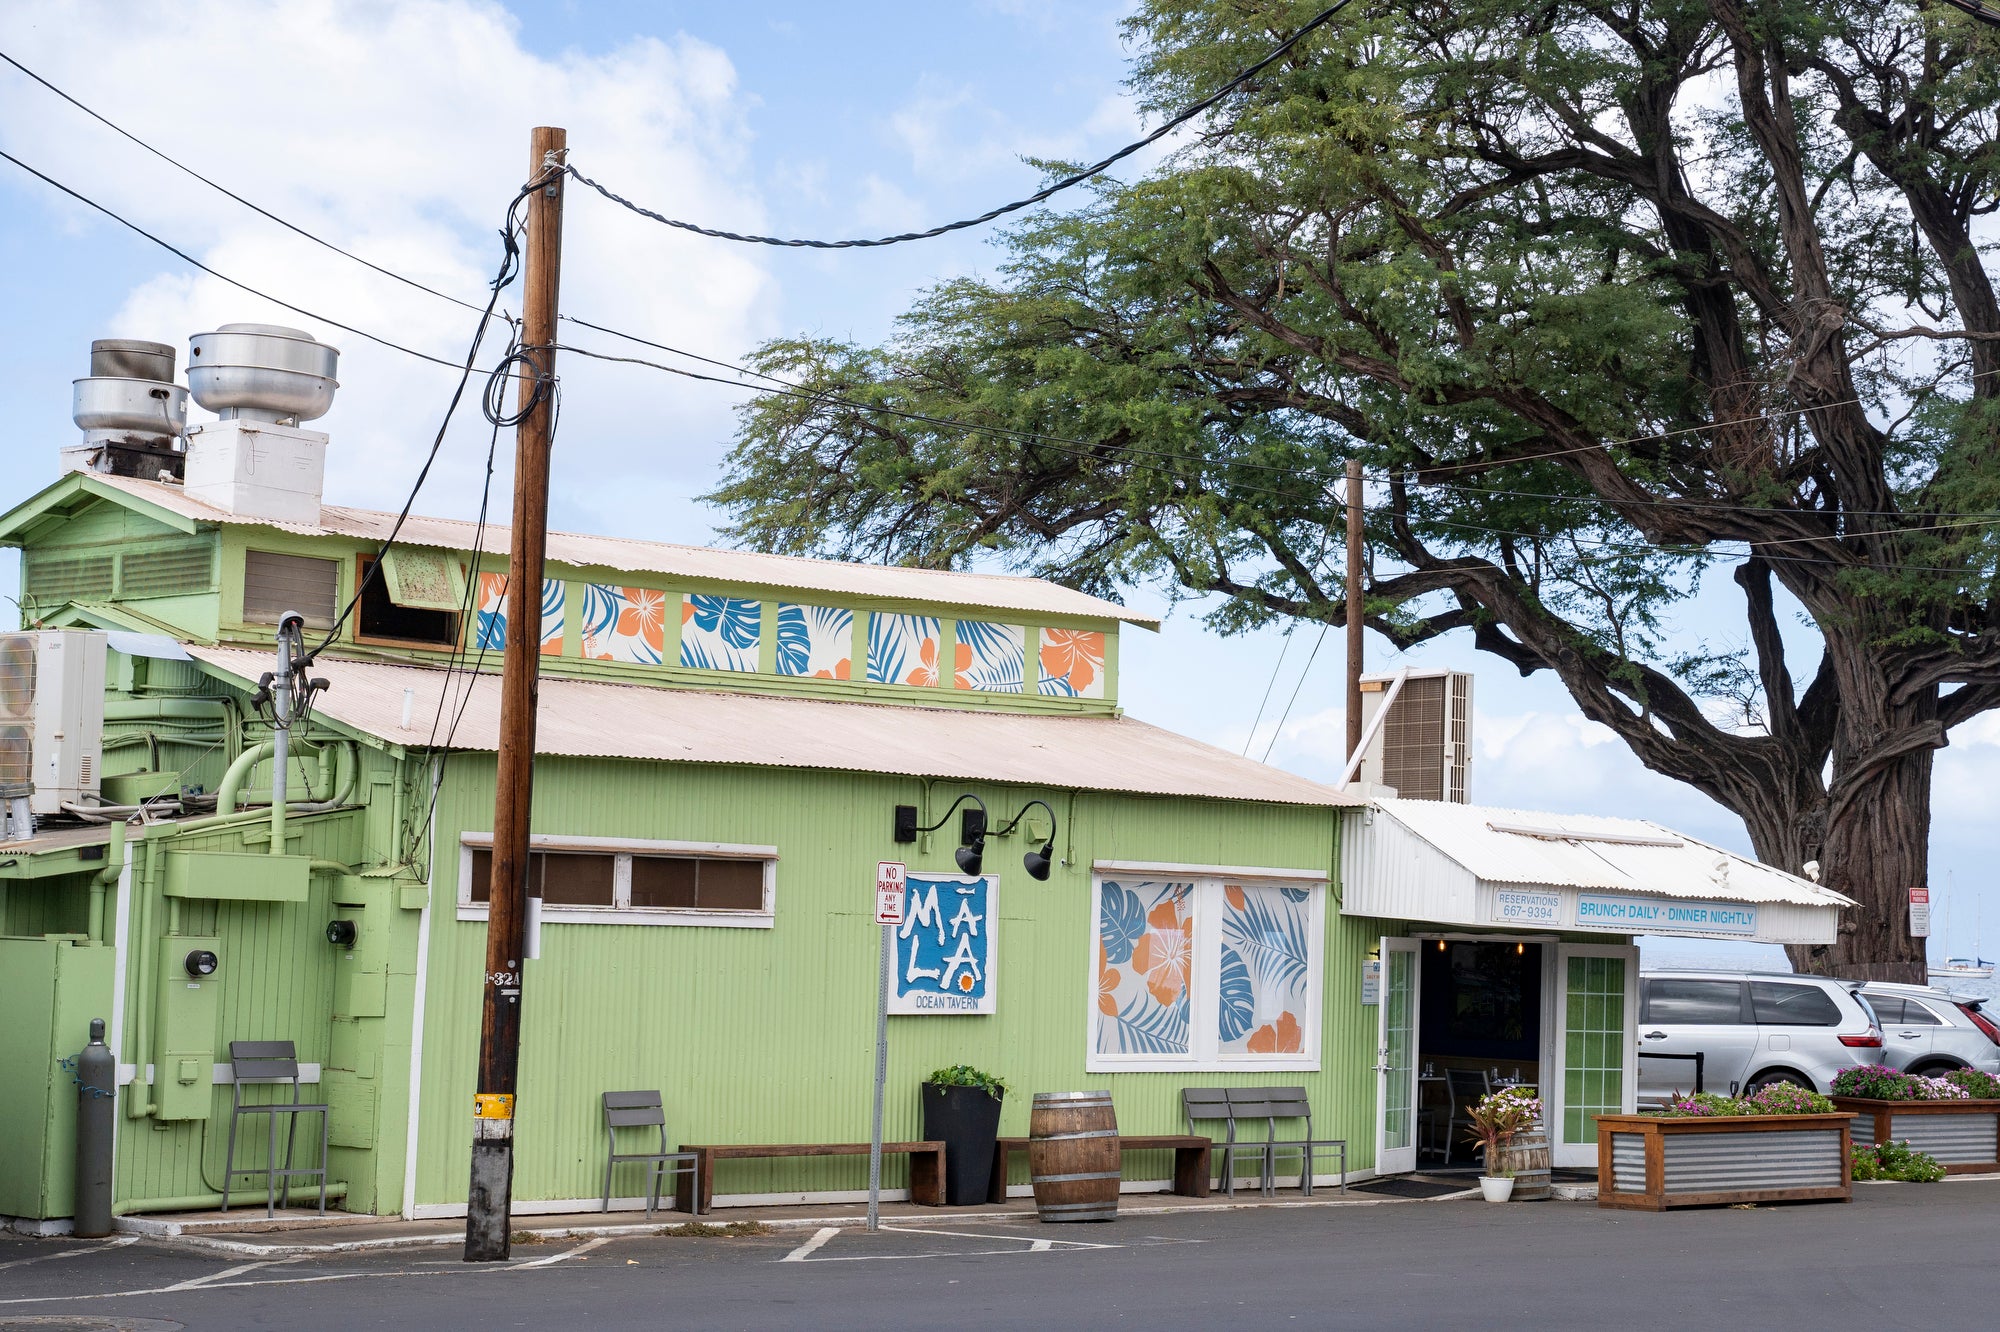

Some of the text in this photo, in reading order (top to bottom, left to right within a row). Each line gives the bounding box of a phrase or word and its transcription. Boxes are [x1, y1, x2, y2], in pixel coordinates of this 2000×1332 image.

[886, 867, 897, 879] NO
[878, 881, 903, 893] PARKING
[885, 894, 896, 903] ANY
[1499, 893, 1559, 907] RESERVATIONS
[884, 903, 896, 912] TIME
[1503, 905, 1552, 918] 667-9394
[1580, 902, 1754, 925] BRUNCH DAILY DINNER NIGHTLY
[916, 995, 979, 1010] OCEAN TAVERN
